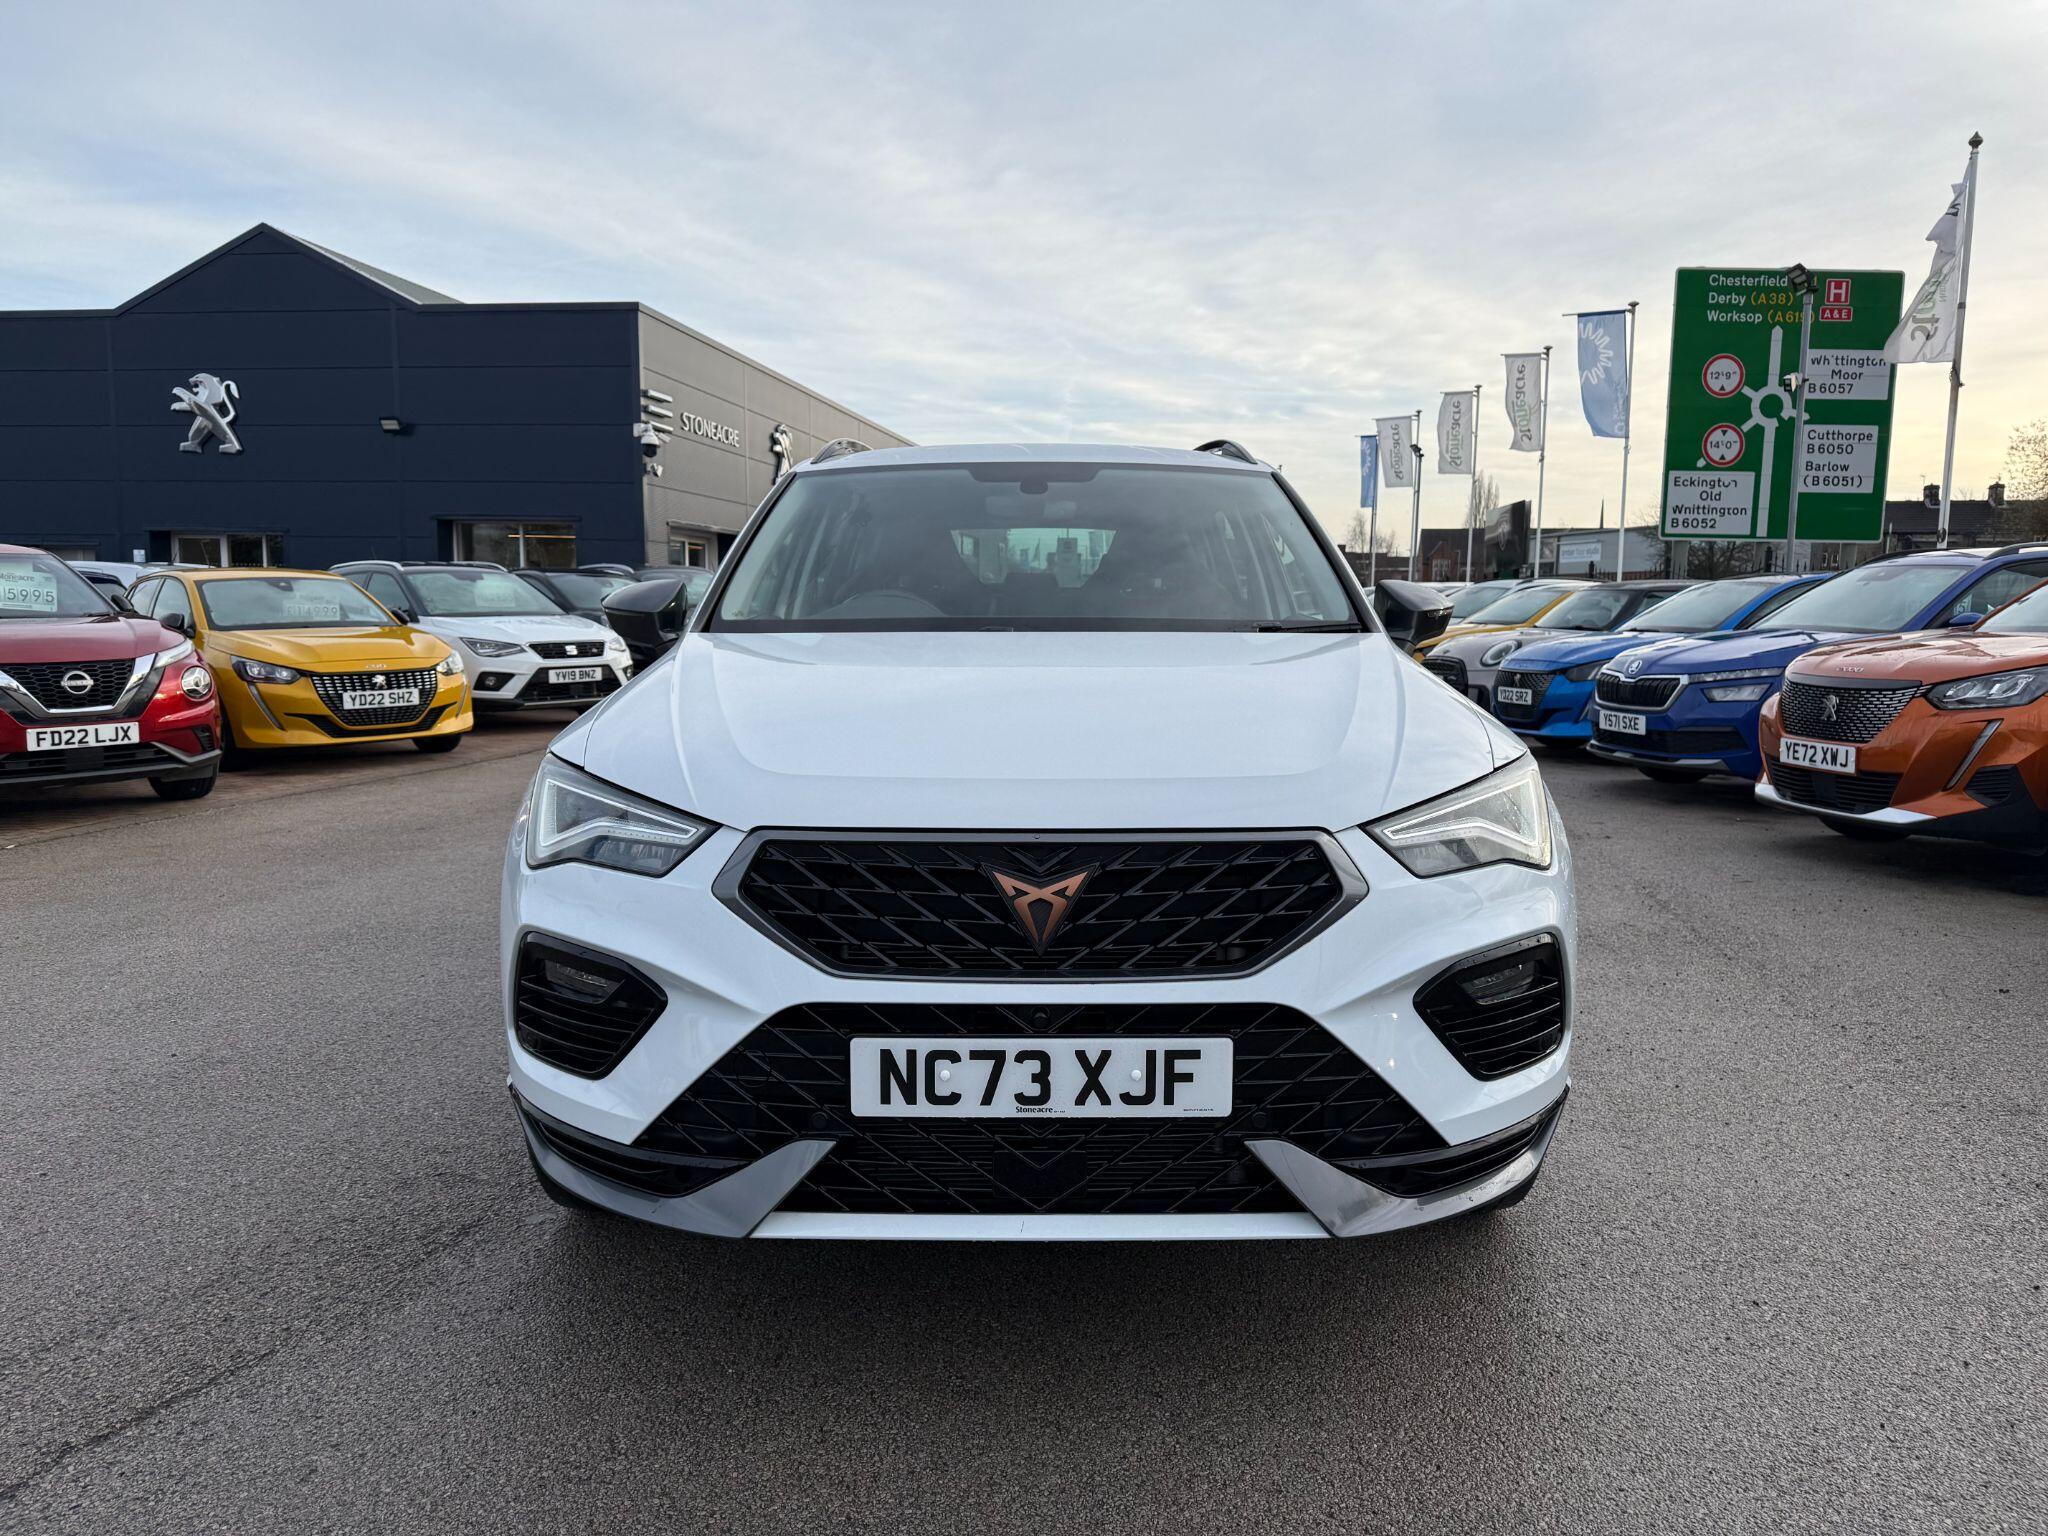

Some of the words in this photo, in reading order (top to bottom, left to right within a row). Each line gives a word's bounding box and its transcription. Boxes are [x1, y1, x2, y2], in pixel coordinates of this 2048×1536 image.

[1709, 274, 1788, 287] Chesterfield
[1708, 292, 1746, 306] Derby
[1829, 281, 1847, 302] H
[1707, 310, 1763, 324] Worksop
[1831, 369, 1863, 380] Moor
[681, 411, 740, 448] STONEACRE
[1807, 429, 1873, 444] Cutthorpe
[1805, 460, 1850, 472] Barlow
[1699, 490, 1722, 501] Old
[555, 670, 577, 681] YV19
[578, 669, 597, 680] BNZ
[349, 693, 385, 707] YD22
[388, 691, 413, 704] SHZ
[1622, 716, 1639, 731] SXE
[36, 728, 89, 748] FD22
[95, 726, 132, 744] LJX
[1785, 741, 1817, 764] YE72
[1820, 745, 1849, 768] XWJ
[880, 1048, 1051, 1106] NC73
[1074, 1049, 1201, 1106] XJF
